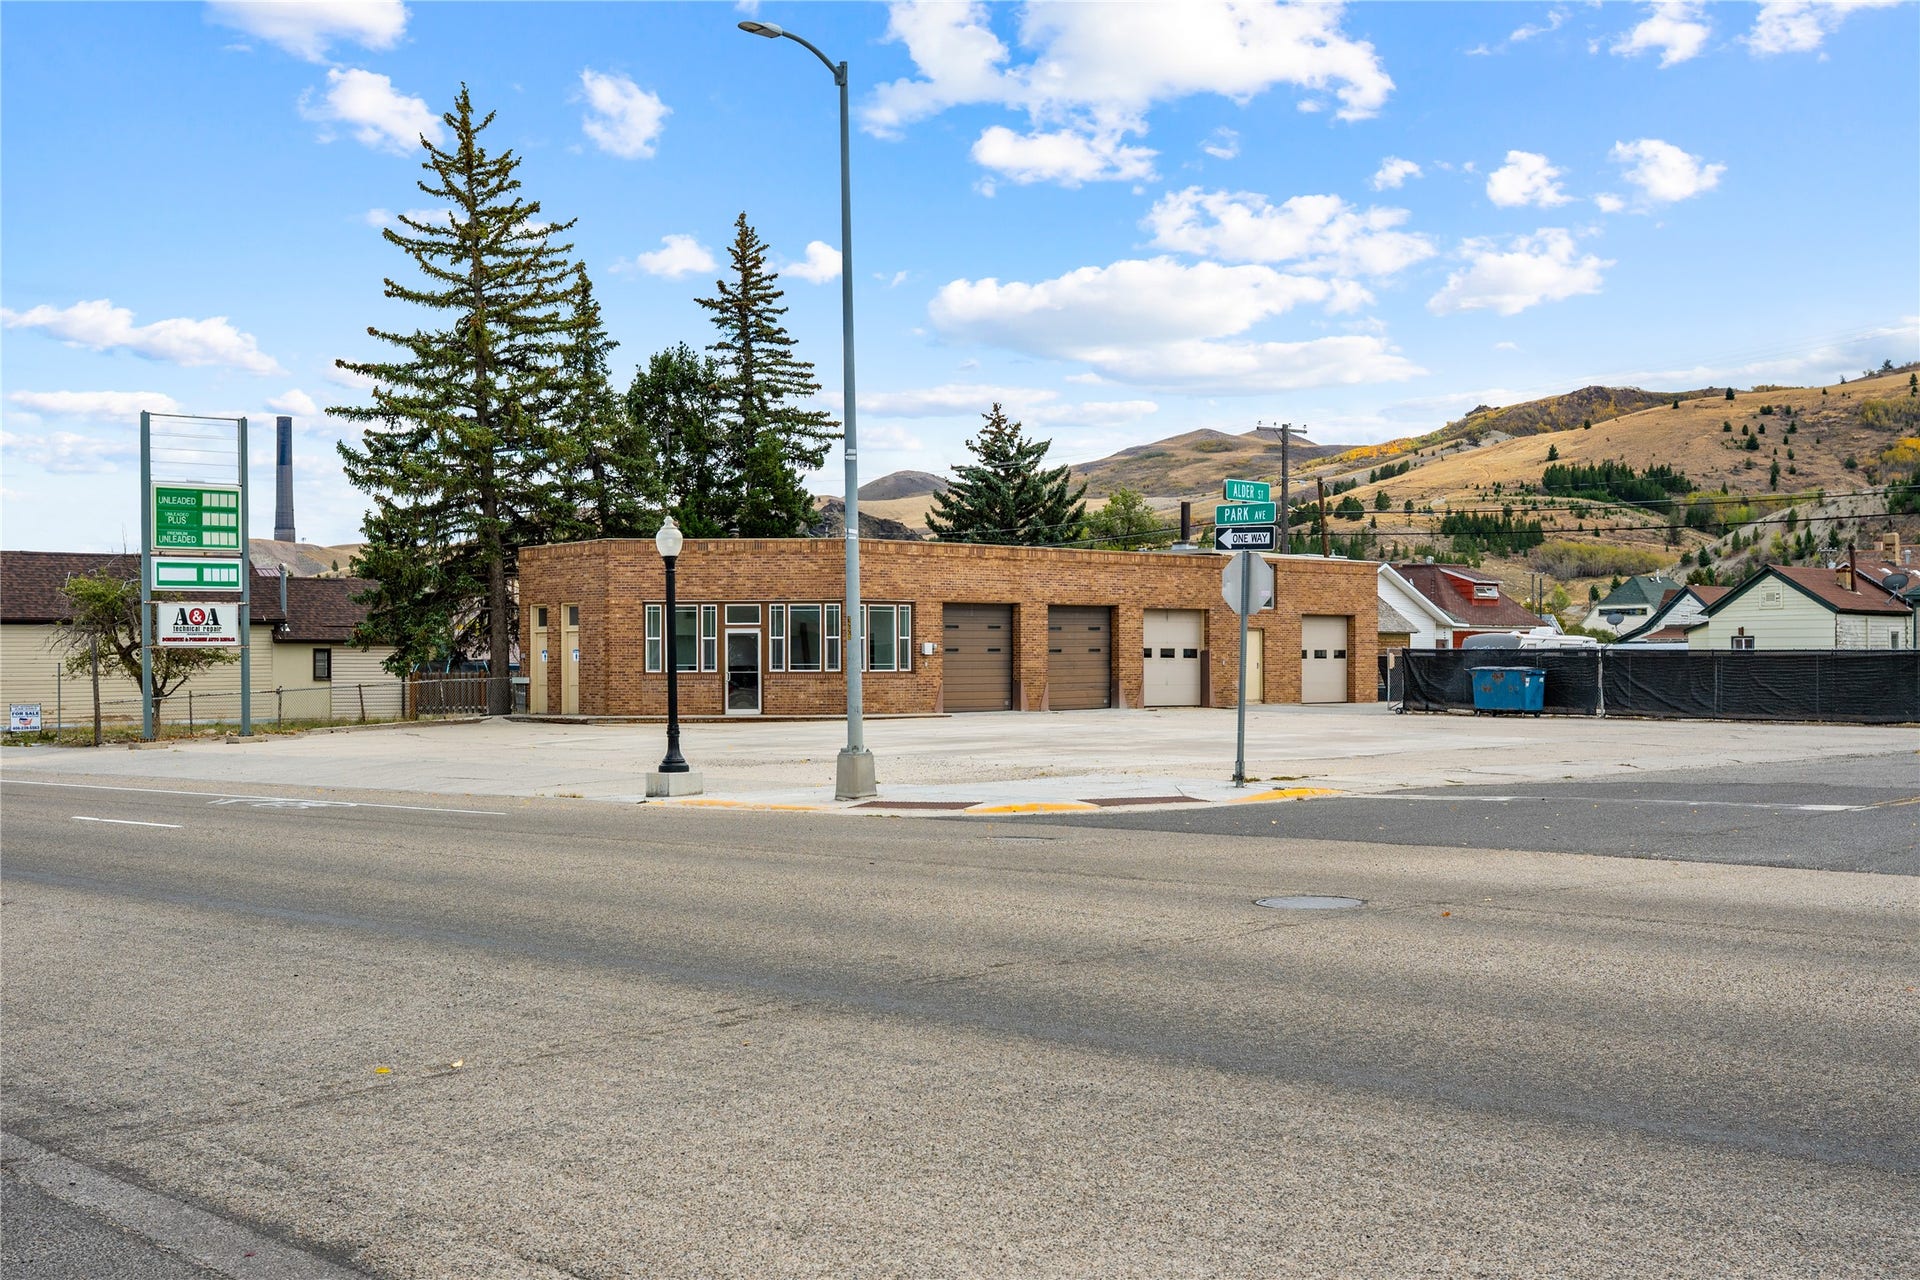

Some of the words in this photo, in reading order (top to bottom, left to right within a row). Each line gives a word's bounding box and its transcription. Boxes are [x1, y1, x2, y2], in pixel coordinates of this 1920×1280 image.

[1233, 483, 1254, 498] ALDER
[1257, 490, 1264, 499] ST
[158, 496, 196, 505] UNLEADED
[1224, 507, 1249, 521] PARK
[1254, 510, 1266, 520] AVE
[168, 517, 187, 525] PLUS
[158, 535, 197, 544] UNLEADED
[1232, 534, 1248, 543] ONE
[1251, 534, 1268, 543] WAY
[173, 608, 221, 625] A&A
